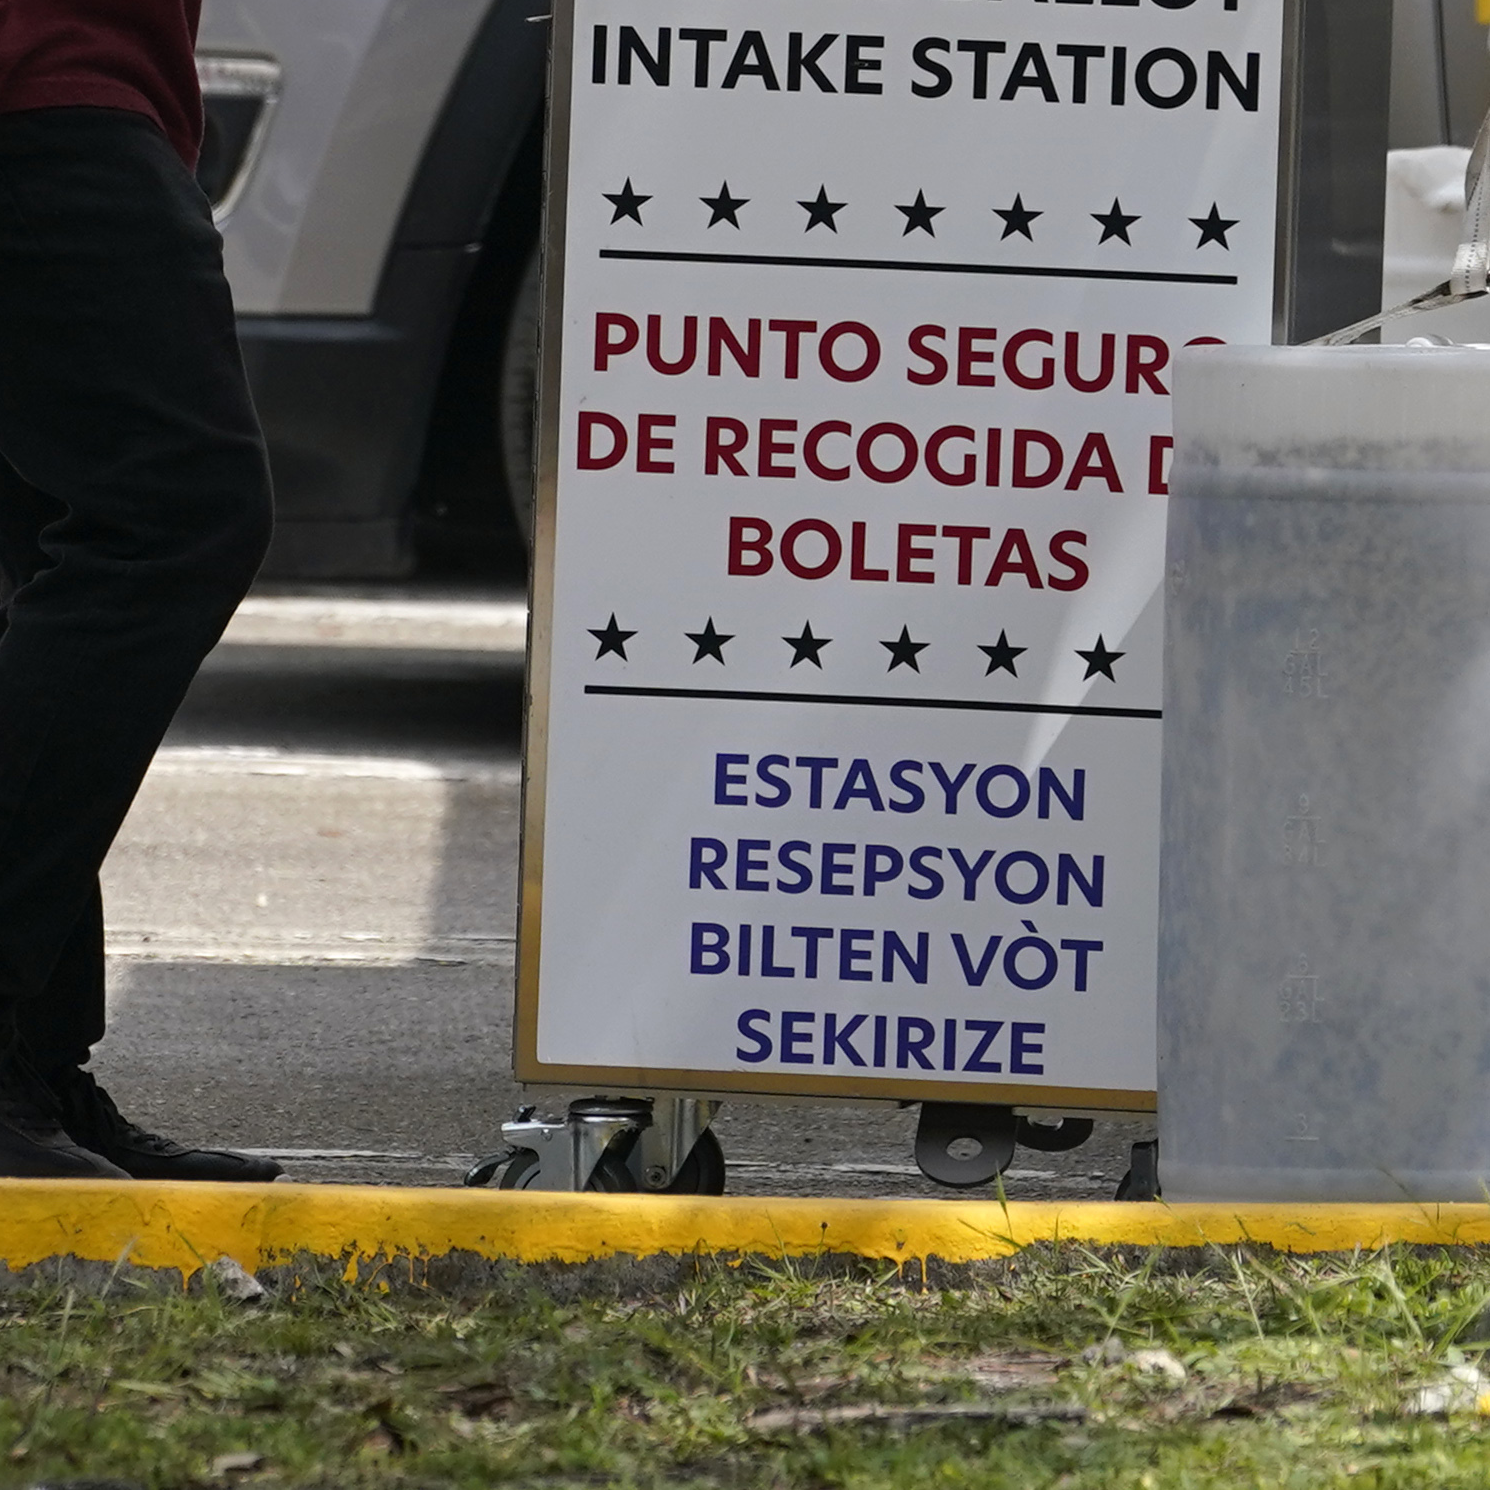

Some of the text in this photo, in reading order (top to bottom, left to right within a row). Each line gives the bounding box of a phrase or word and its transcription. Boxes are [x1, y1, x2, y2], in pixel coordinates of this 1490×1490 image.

[591, 24, 1260, 112] INTAKE STATION
[594, 312, 1226, 397] PUNTO SEGUR
[576, 411, 677, 474] DE
[704, 416, 1124, 493] RECOGIDA
[727, 516, 1089, 592] BOLETAS
[1283, 653, 1329, 676] GAL
[714, 753, 1086, 821] ESTASYON
[689, 837, 1105, 908] RESEPSYON
[690, 919, 1104, 992] BILTEN VÒT
[736, 1008, 1046, 1076] SEKIRIZE
